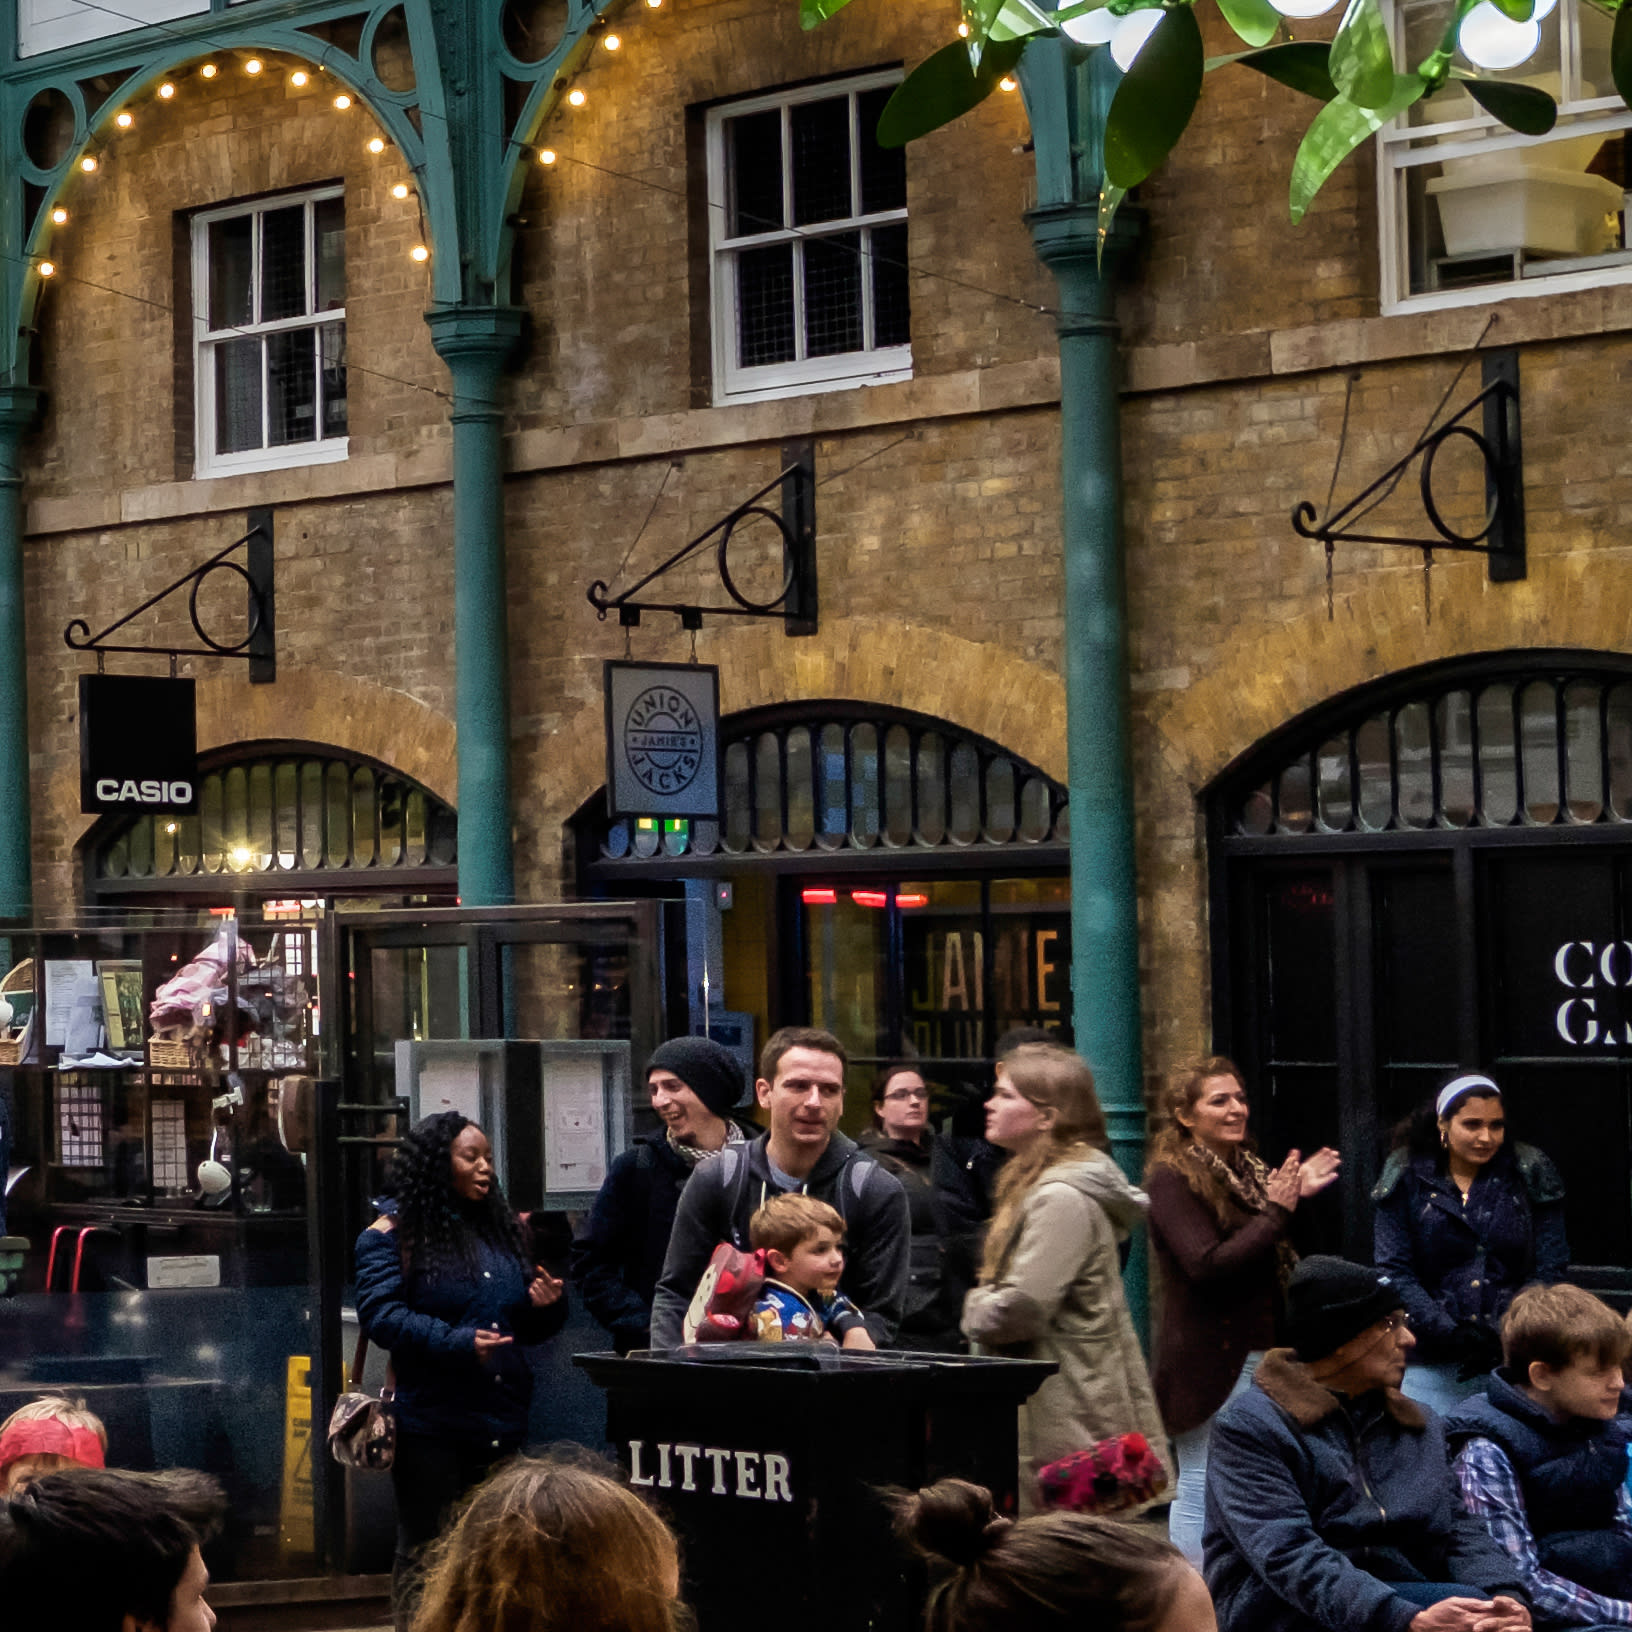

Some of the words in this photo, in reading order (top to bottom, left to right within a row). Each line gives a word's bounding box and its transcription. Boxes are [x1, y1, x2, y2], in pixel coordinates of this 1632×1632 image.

[631, 693, 694, 728] UNION
[631, 753, 696, 789] JACKS
[96, 779, 192, 804] CASIO
[911, 929, 1061, 1013] JAMIE
[628, 1439, 793, 1503] LITTER
